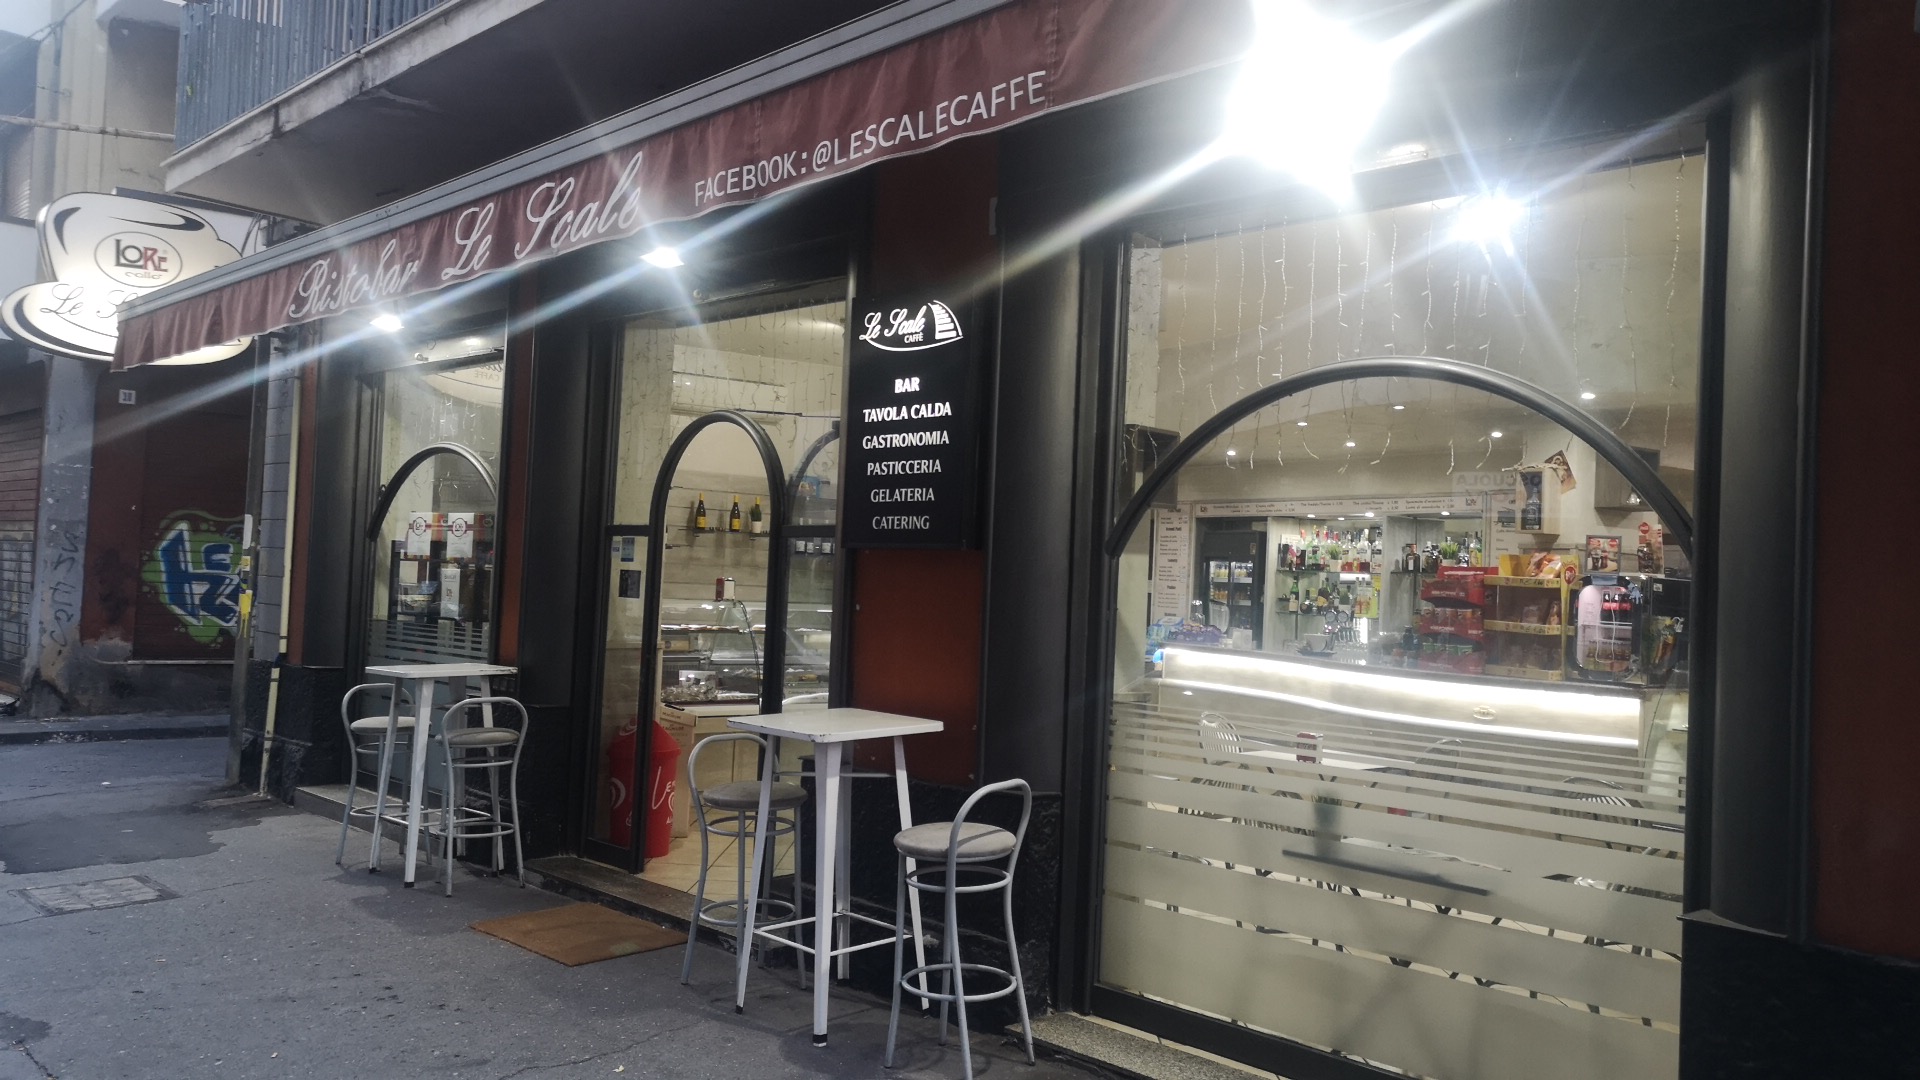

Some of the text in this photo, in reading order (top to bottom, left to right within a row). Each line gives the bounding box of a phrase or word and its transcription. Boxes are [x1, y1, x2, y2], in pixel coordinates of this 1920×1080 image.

[289, 150, 643, 318] Ristobar Le Scale
[40, 283, 84, 316] Le
[859, 304, 927, 340] Le Scale
[895, 377, 920, 394] BAR
[863, 402, 952, 423] TAVOLA CALDA
[862, 430, 949, 450] GASTRONOMIA
[867, 459, 942, 476] PASTICCERIA
[870, 487, 935, 503] GELATERIA
[872, 515, 930, 530] CATERING
